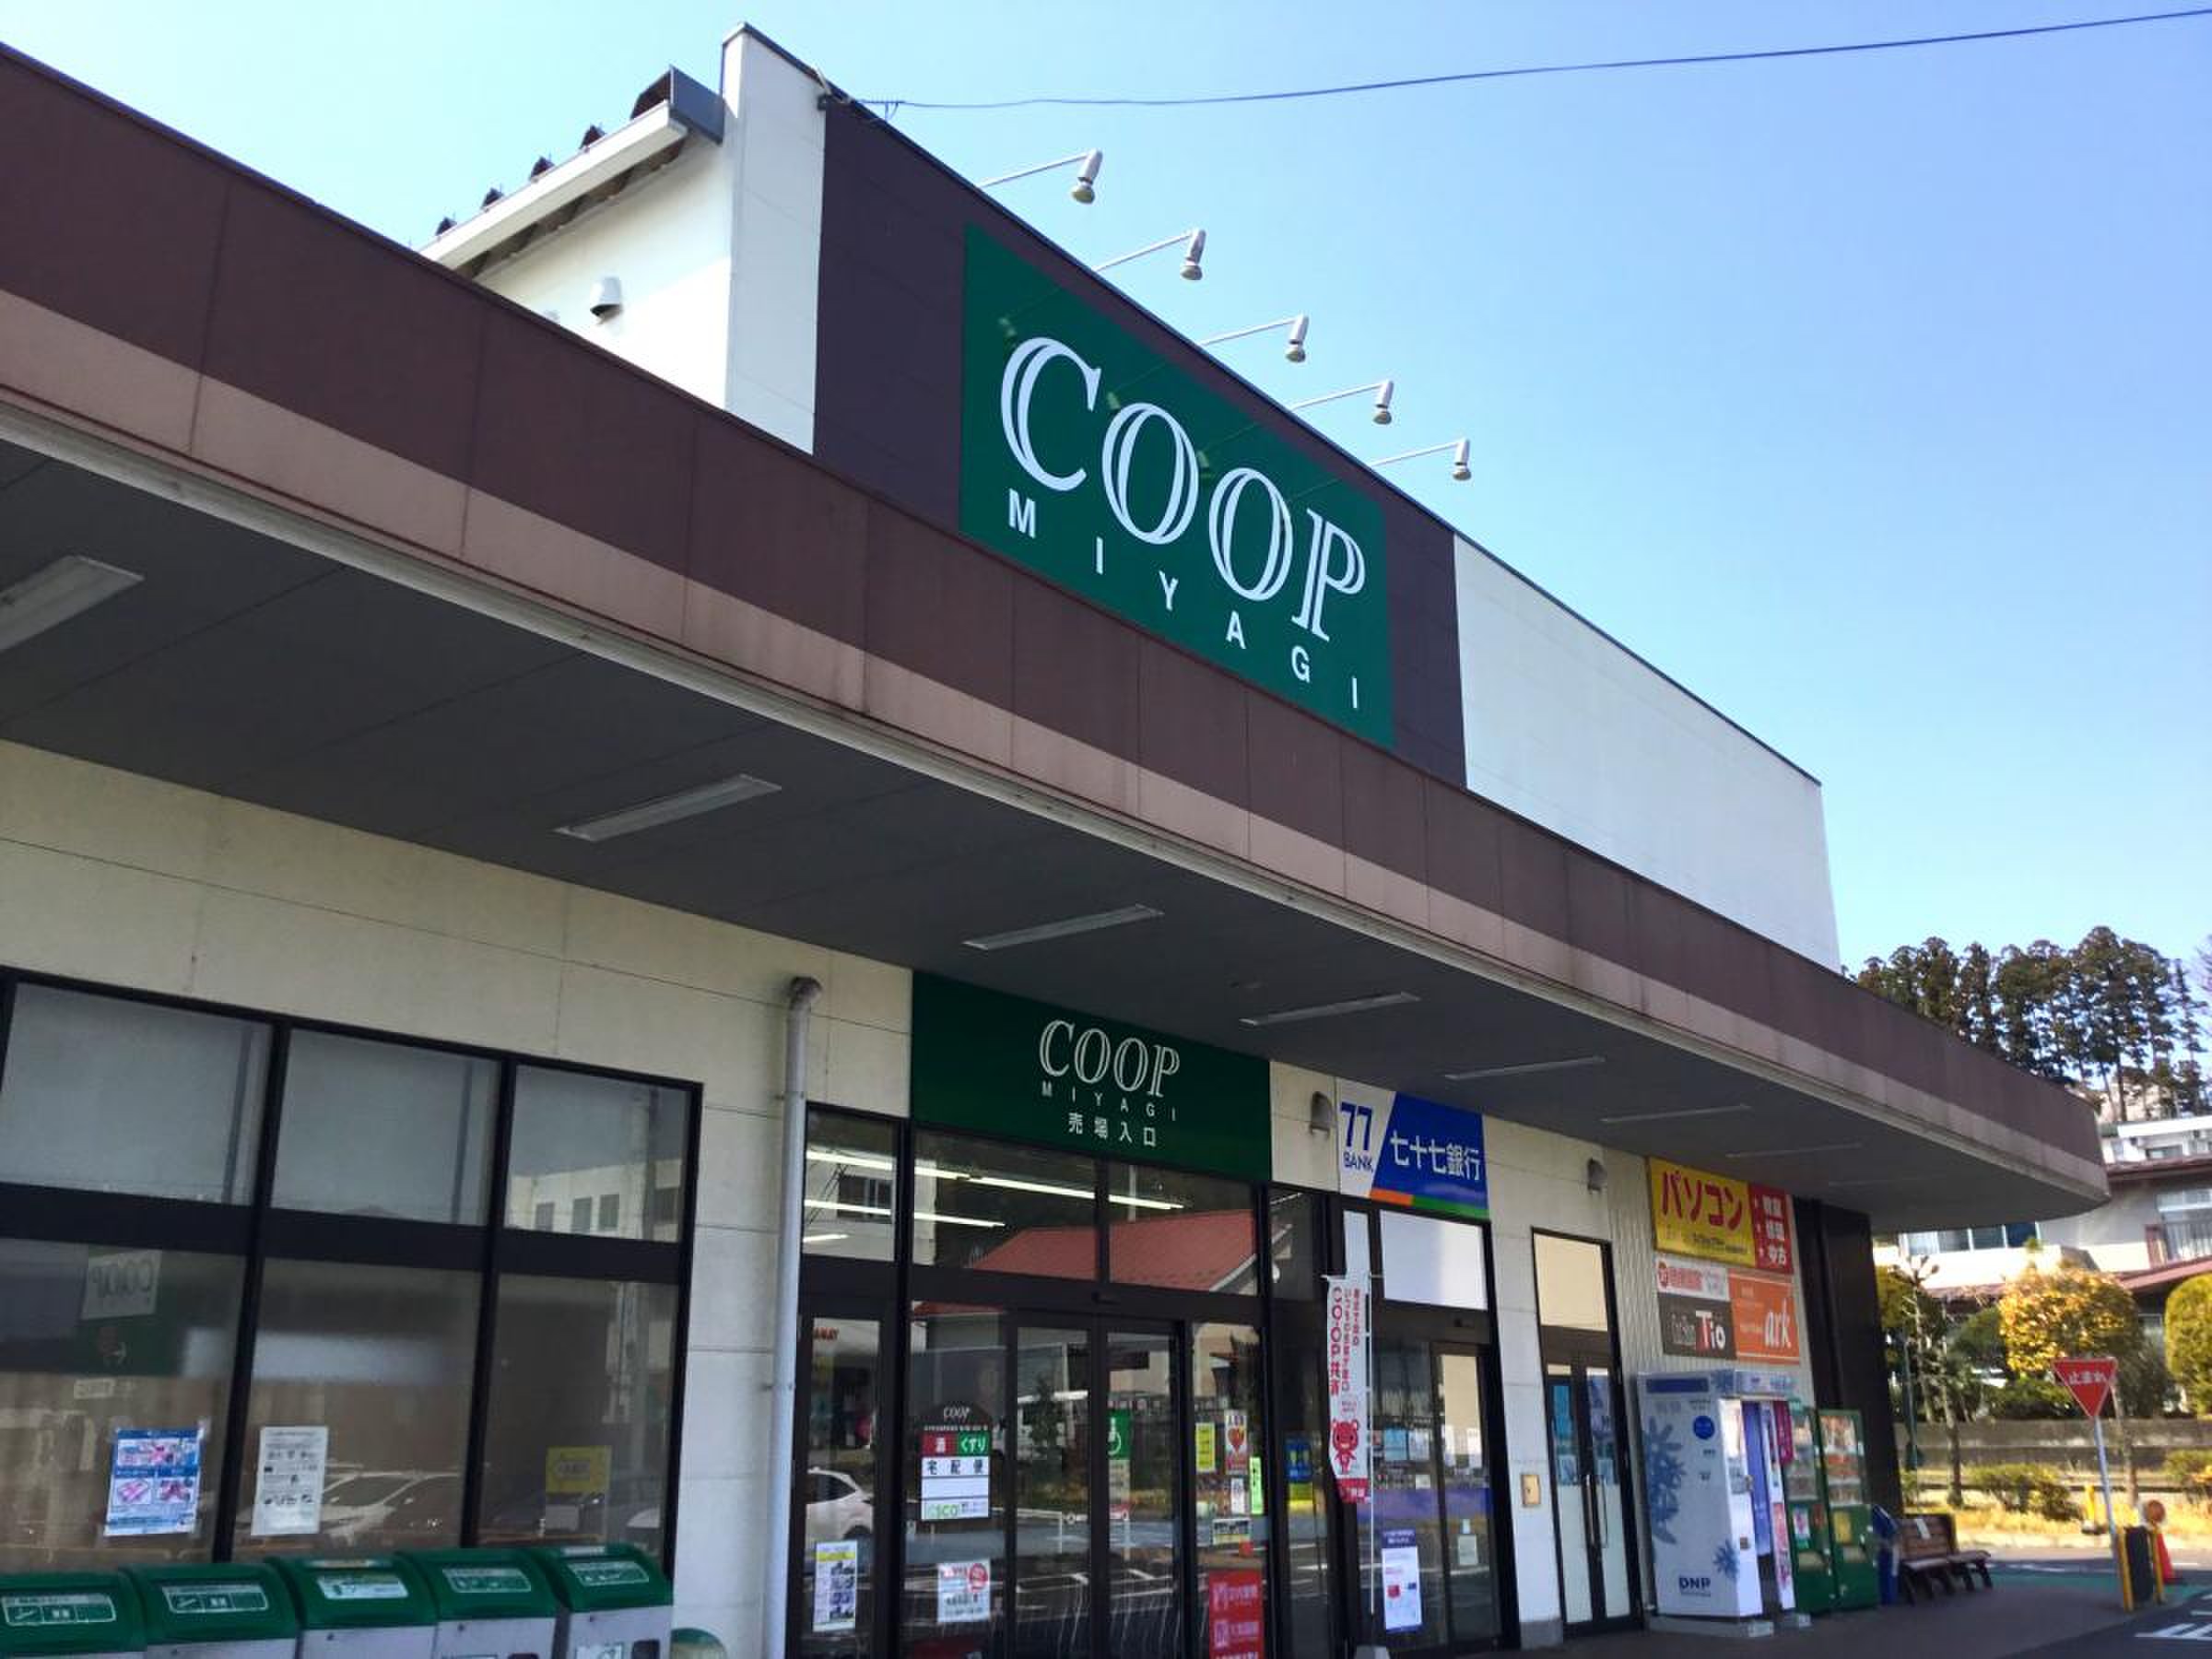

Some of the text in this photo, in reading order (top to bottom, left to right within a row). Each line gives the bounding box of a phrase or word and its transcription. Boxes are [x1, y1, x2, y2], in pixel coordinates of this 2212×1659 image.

[1000, 336, 1367, 642] COOP
[1008, 488, 1359, 710] MIYAGI
[1039, 1018, 1181, 1098] COOP
[1041, 1079, 1176, 1122] MIYAGI
[1340, 1100, 1372, 1151] 77
[1068, 1112, 1157, 1147] 売場入口
[1390, 1129, 1480, 1181] 七十七銀行
[1343, 1151, 1373, 1173] BANK
[1661, 1170, 1743, 1231] パソコン
[1678, 1576, 1712, 1590] DNP
